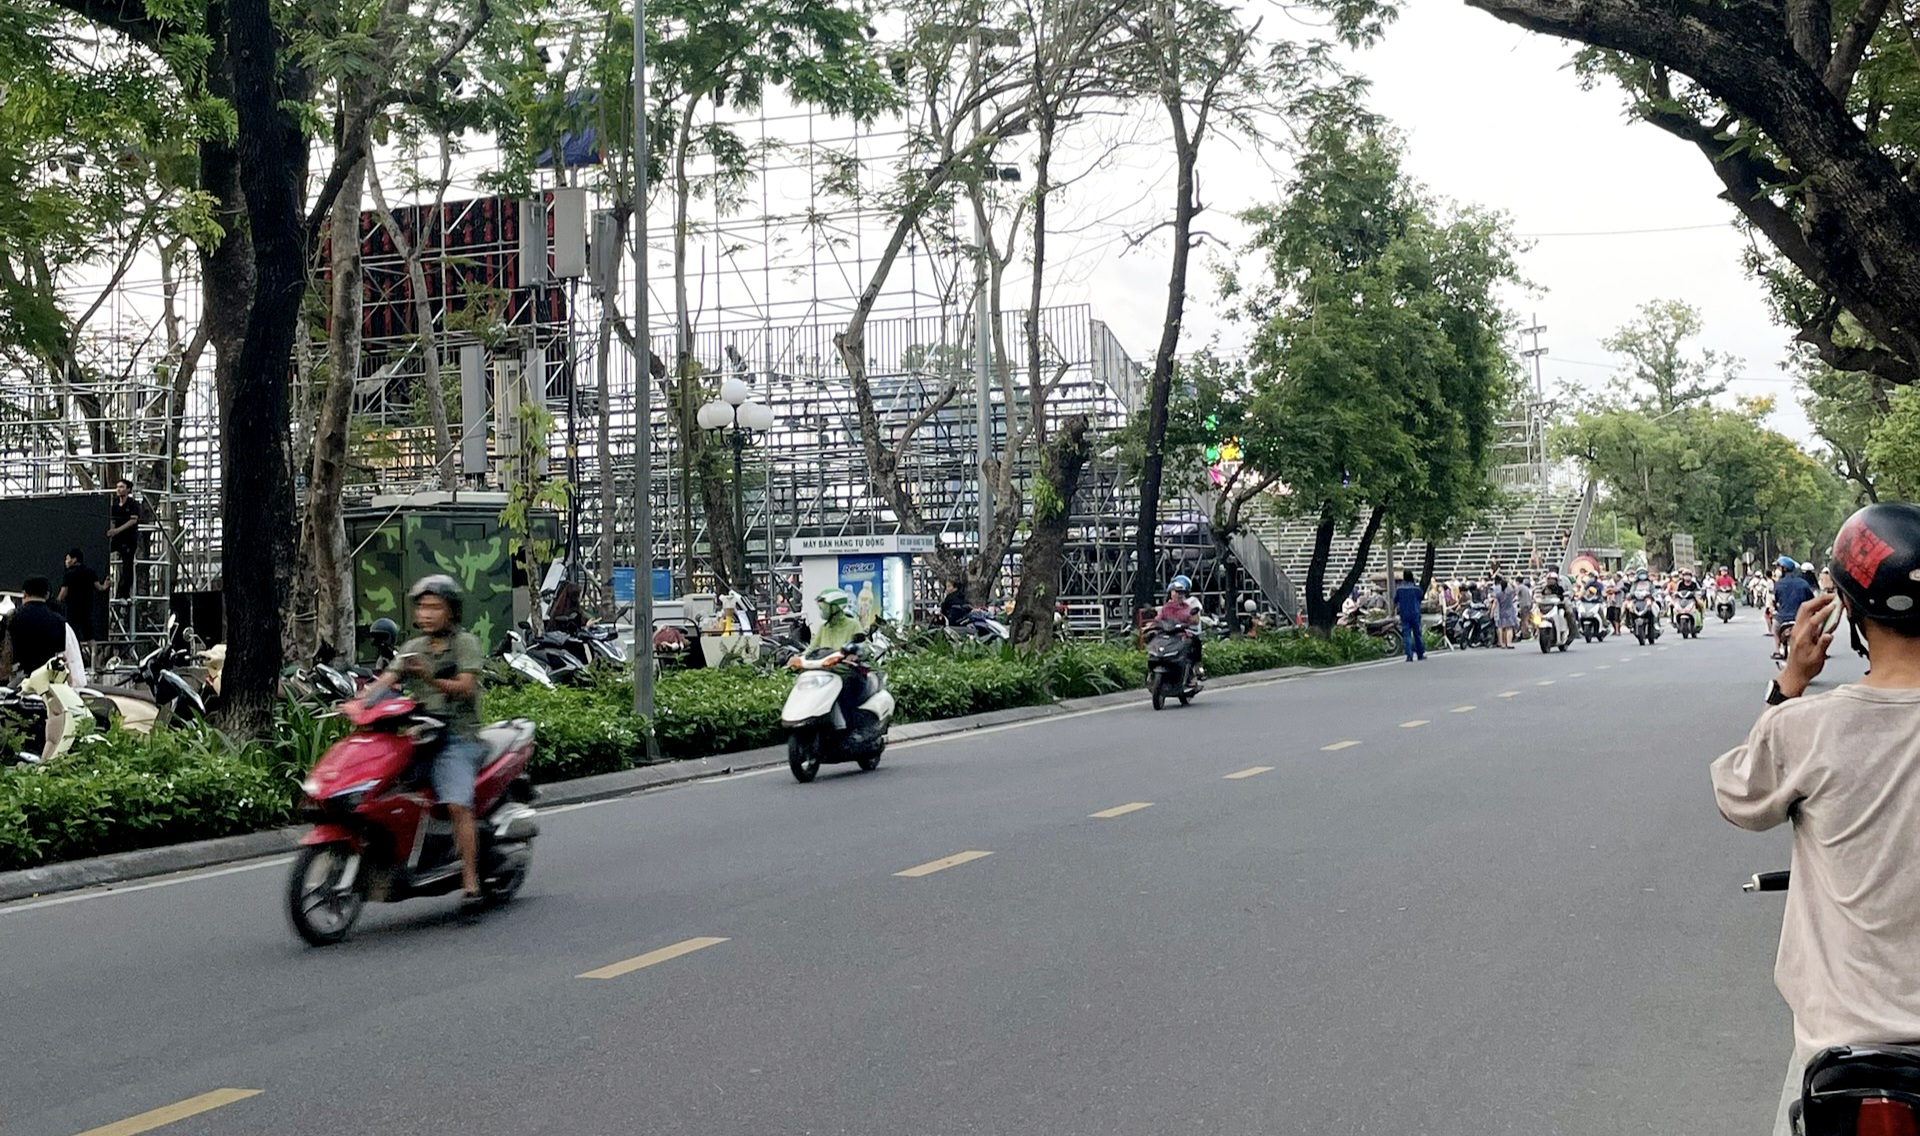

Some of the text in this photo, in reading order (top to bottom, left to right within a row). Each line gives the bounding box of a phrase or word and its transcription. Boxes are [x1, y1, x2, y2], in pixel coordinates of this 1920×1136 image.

[803, 537, 884, 548] MÁY BÁN HÀNG TỰ ĐỘNG
